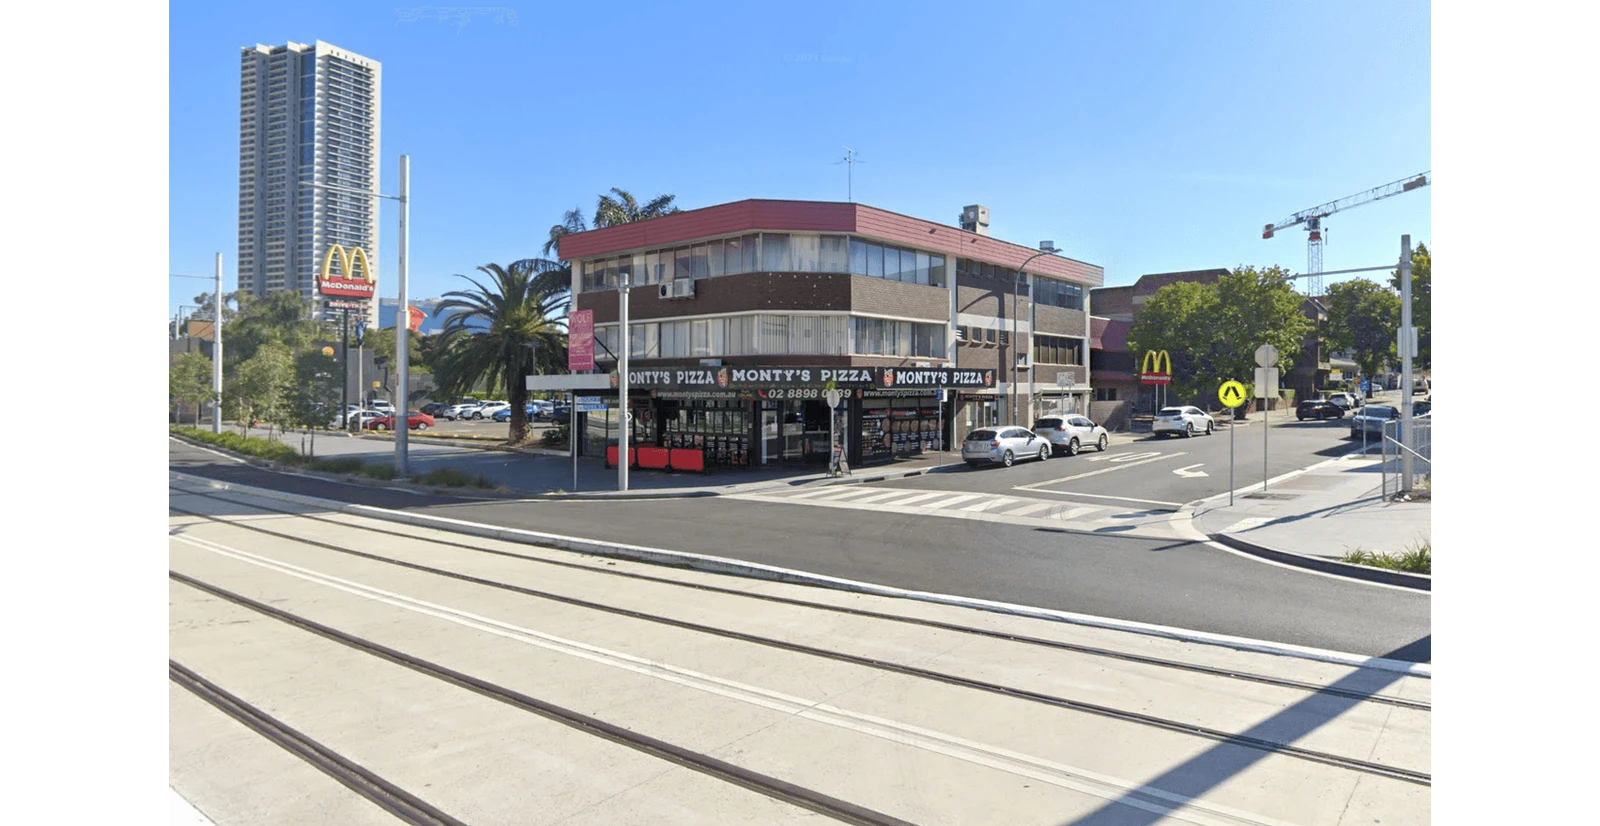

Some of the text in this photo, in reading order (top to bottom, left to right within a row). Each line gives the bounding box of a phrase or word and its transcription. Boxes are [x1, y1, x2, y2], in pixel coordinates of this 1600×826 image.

[321, 281, 374, 292] McDonald's
[628, 371, 715, 385] ONTY'S PIZZA
[732, 369, 872, 382] MONTY'S PIZZA
[896, 371, 983, 384] MONTY'S PIZZA
[657, 391, 736, 399] www.montyspizza.com.au
[768, 389, 852, 399] 02 8898 039
